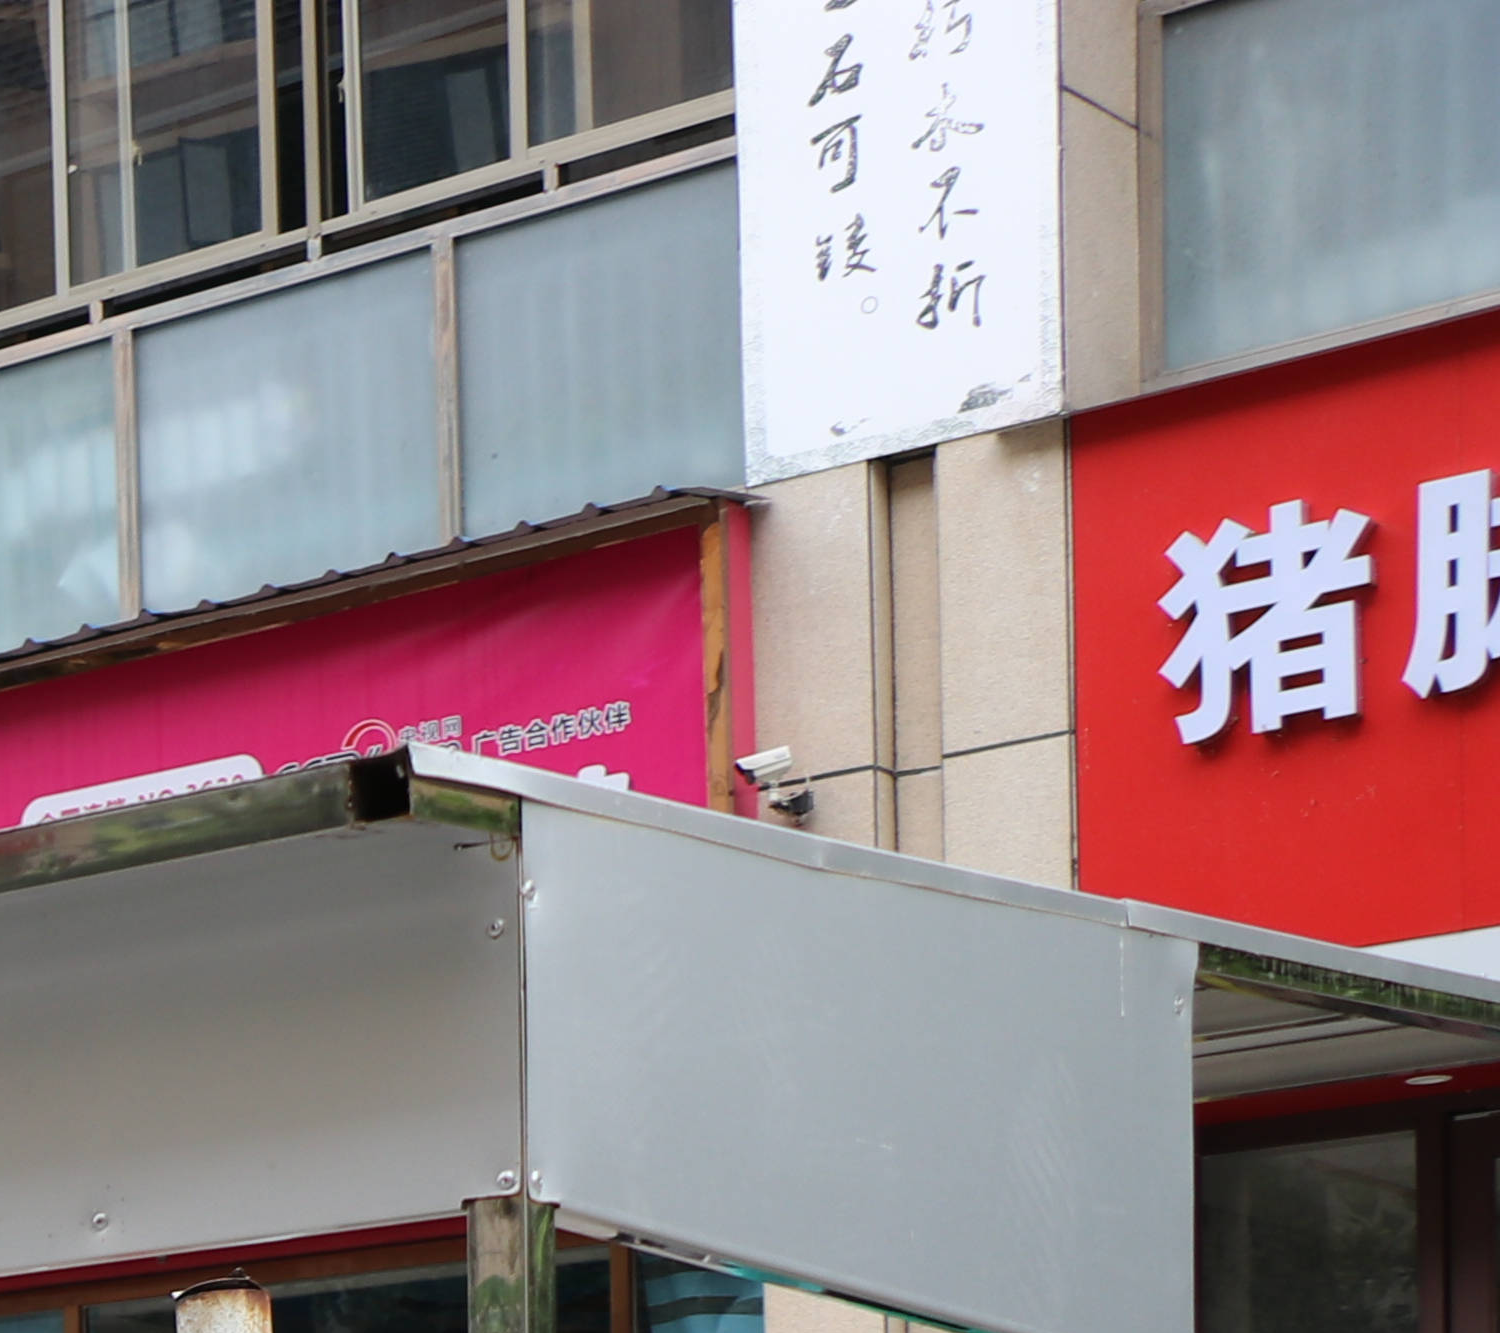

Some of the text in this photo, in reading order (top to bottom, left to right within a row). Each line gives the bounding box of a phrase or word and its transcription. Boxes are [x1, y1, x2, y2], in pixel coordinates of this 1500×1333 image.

[471, 700, 632, 756] 广告合作伙伴
